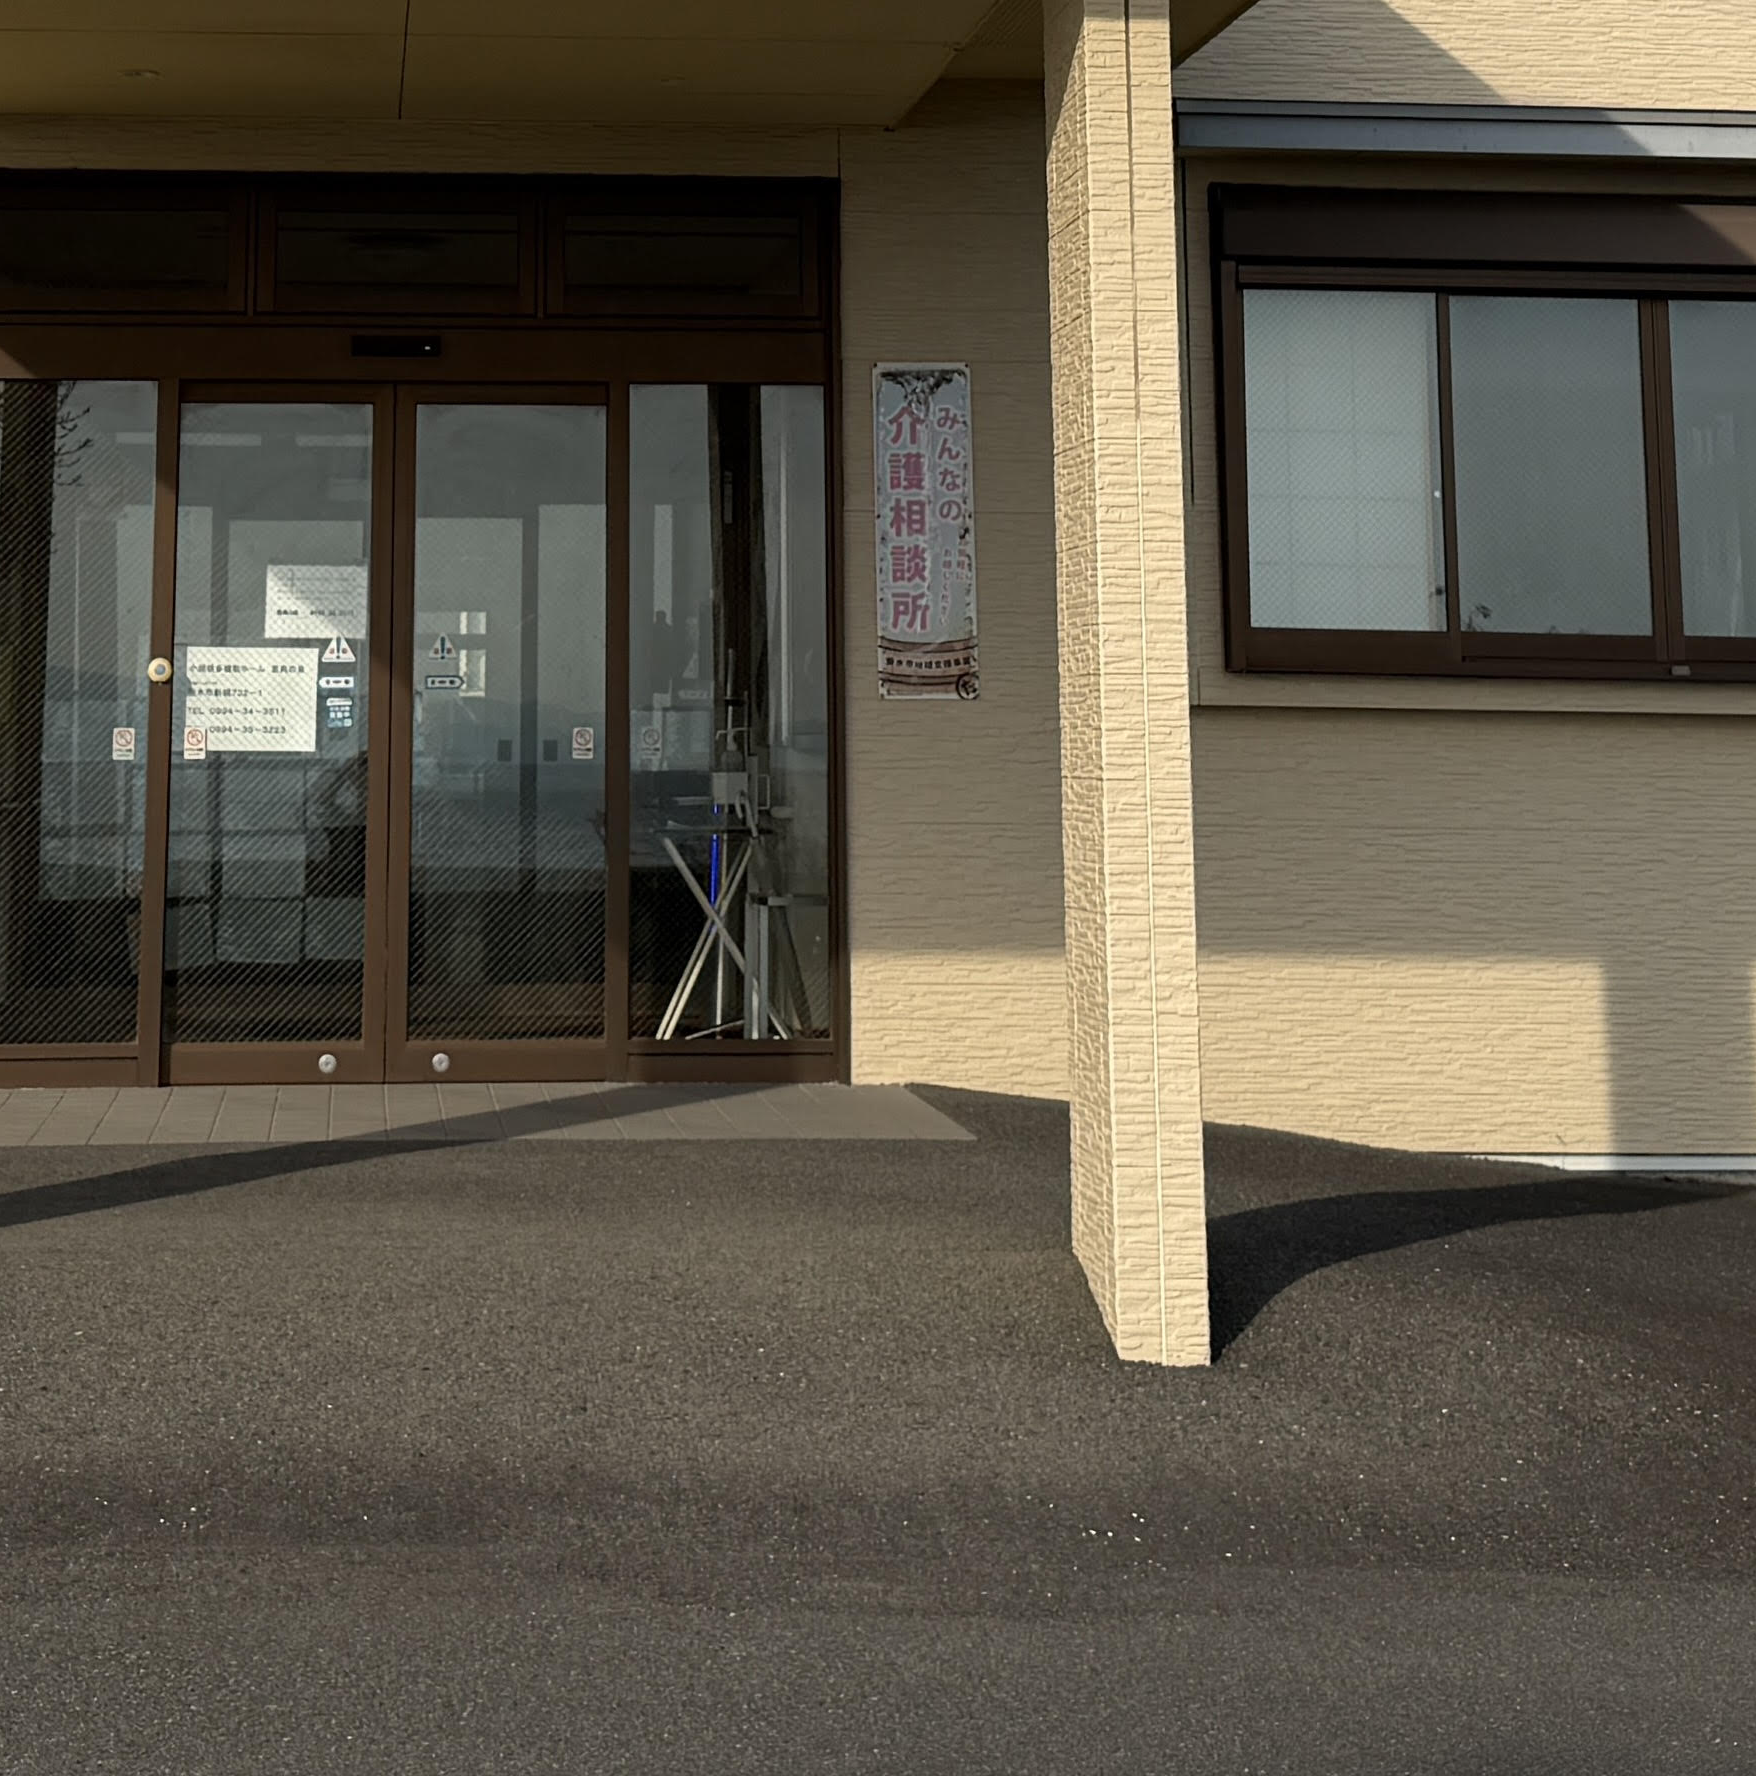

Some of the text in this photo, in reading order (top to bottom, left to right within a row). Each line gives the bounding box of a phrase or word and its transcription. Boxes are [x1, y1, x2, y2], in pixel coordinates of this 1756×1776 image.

[887, 405, 930, 631] 介護相談所
[935, 406, 964, 522] みんなの
